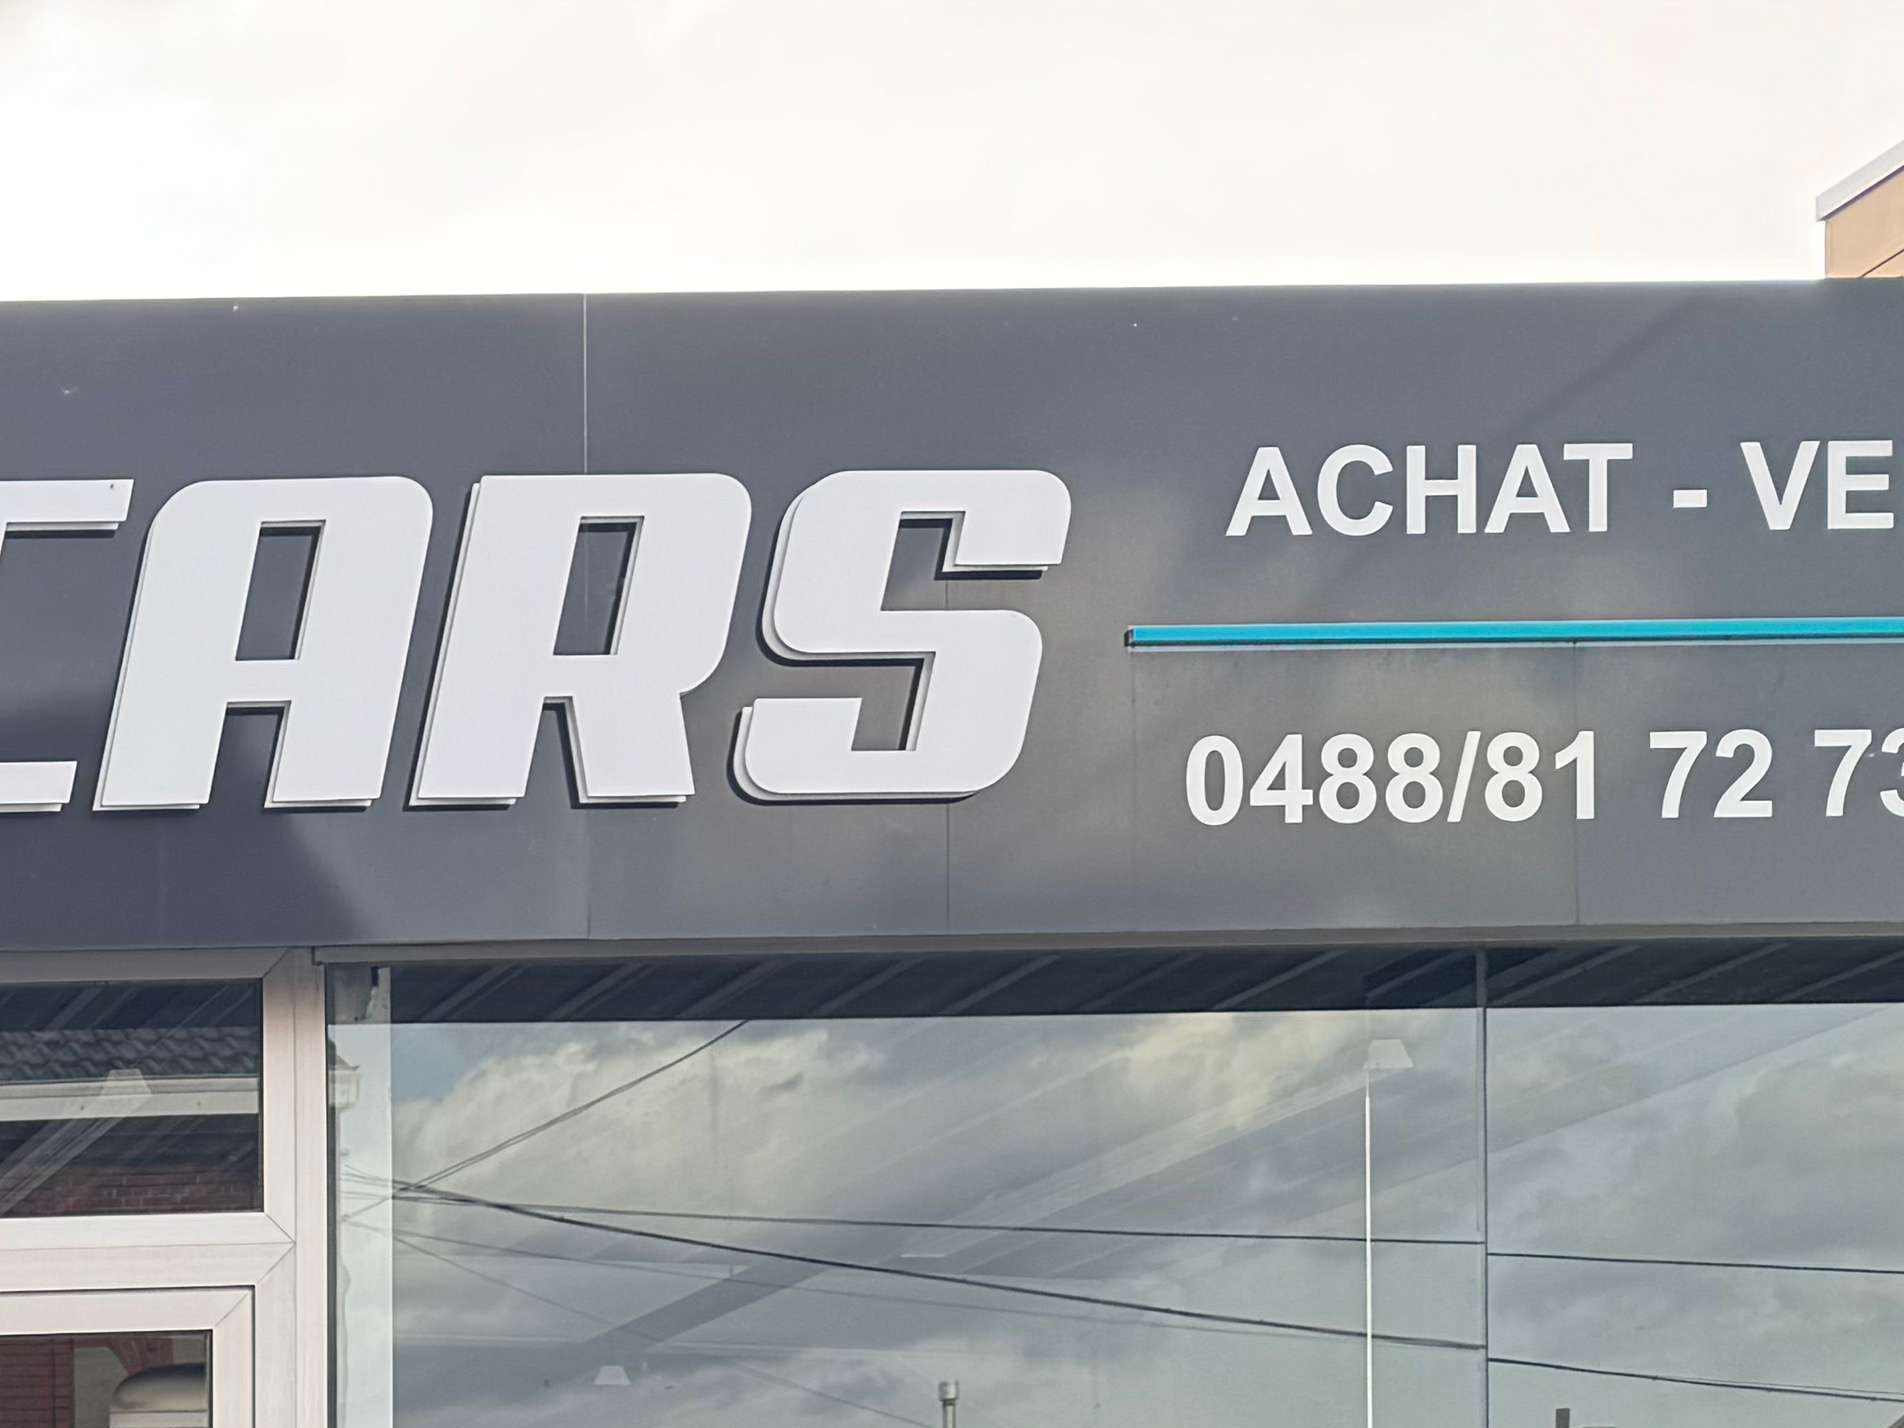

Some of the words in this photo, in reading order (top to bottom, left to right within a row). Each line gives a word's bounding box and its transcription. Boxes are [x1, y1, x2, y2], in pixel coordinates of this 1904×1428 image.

[1226, 444, 1633, 537] ACHAT
[1672, 489, 1708, 508] -
[1740, 440, 1895, 531] VE
[1186, 731, 1596, 827] 0488/81
[1649, 730, 1774, 819] 72
